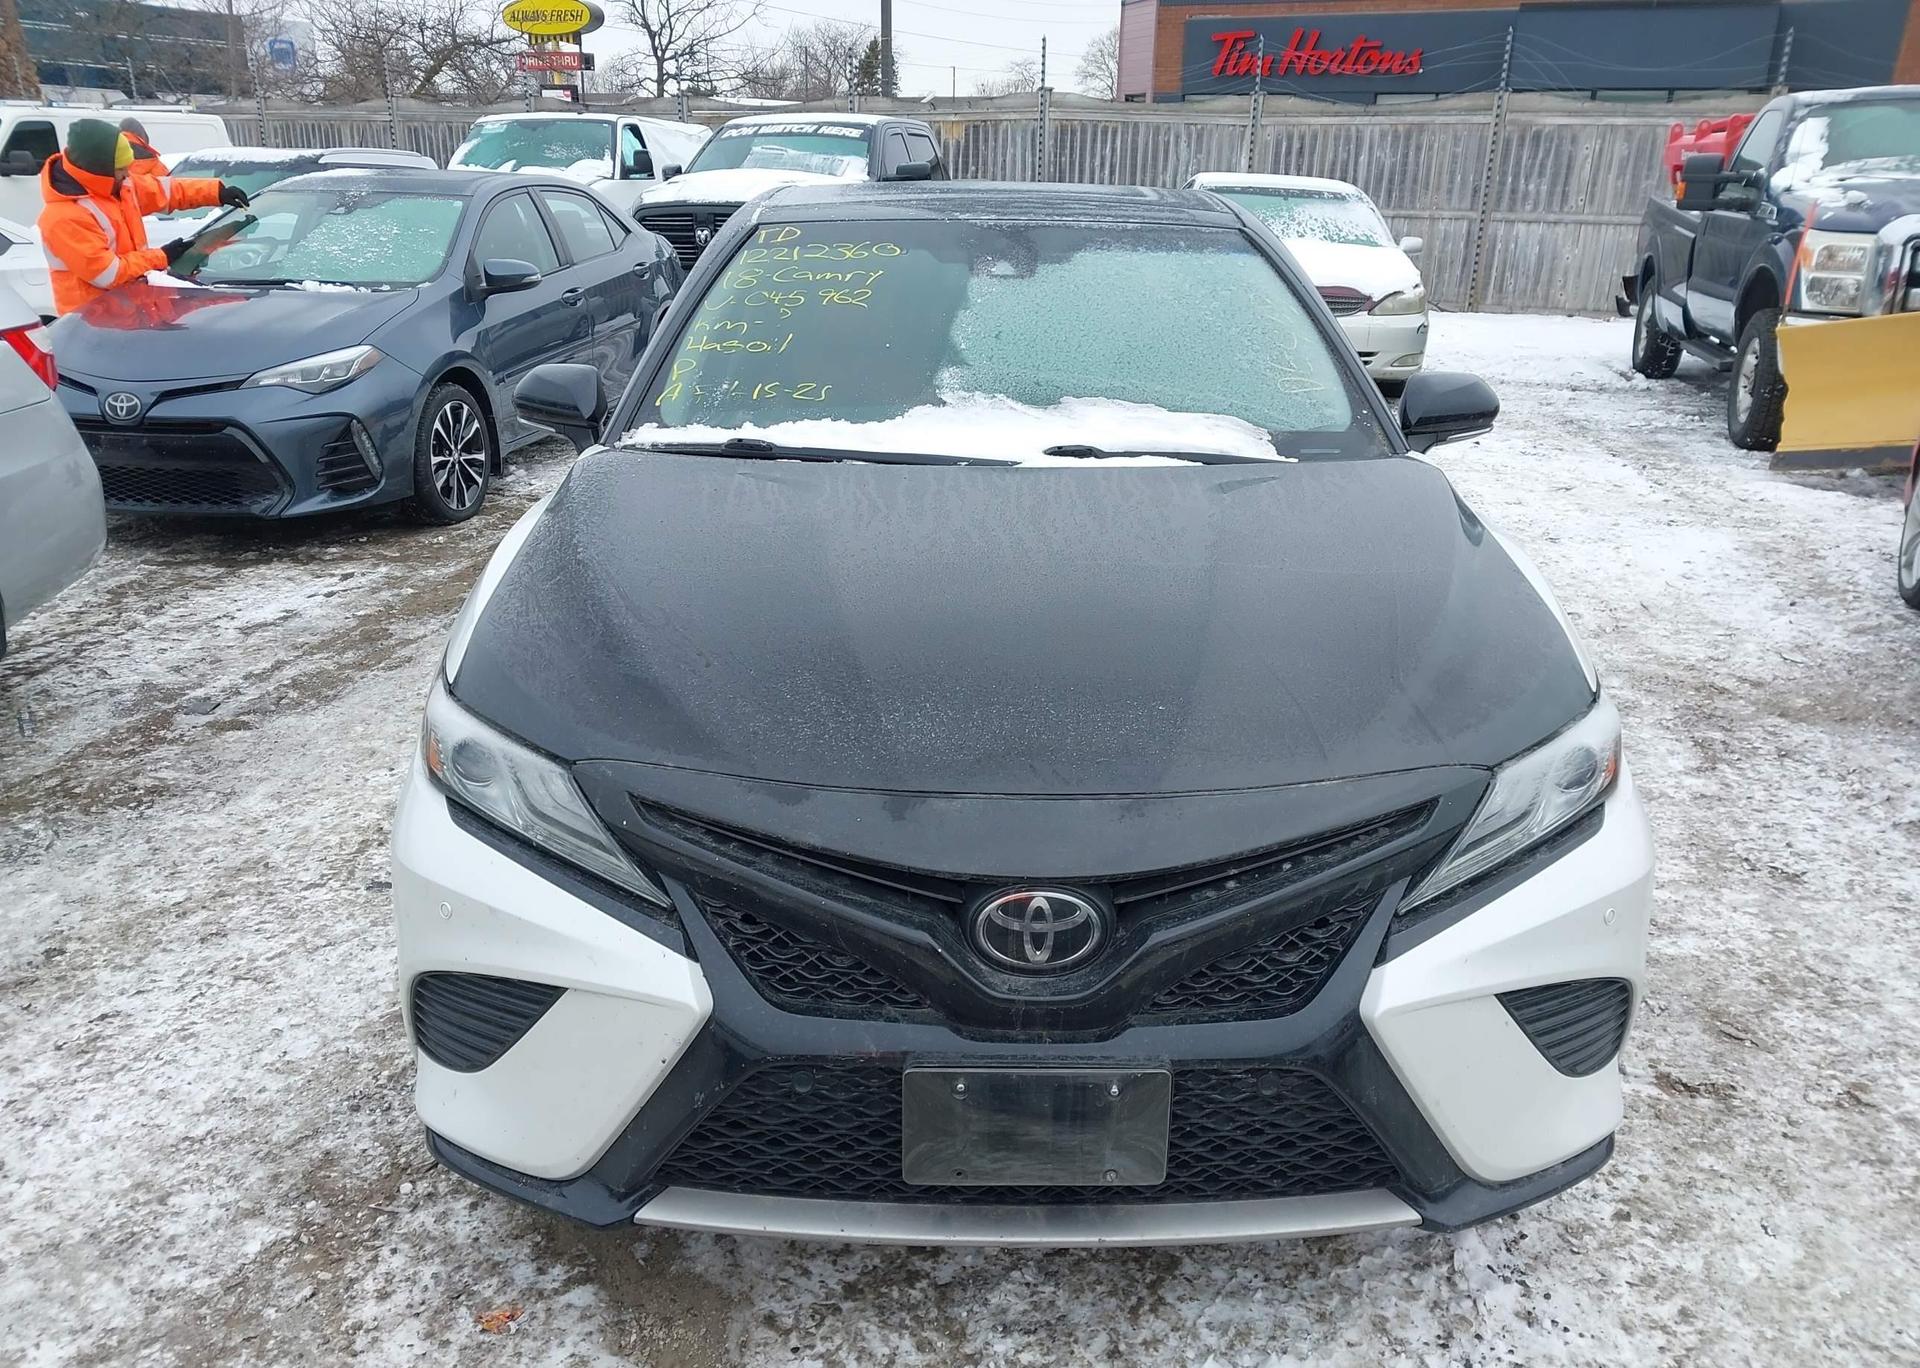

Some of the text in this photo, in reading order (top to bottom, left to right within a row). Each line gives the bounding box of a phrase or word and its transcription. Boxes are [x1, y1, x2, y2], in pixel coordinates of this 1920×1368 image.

[509, 9, 584, 22] ALWAYS FRESH
[1212, 28, 1424, 77] Tim Hortons
[758, 124, 819, 135] WATCH
[817, 126, 865, 138] HERE
